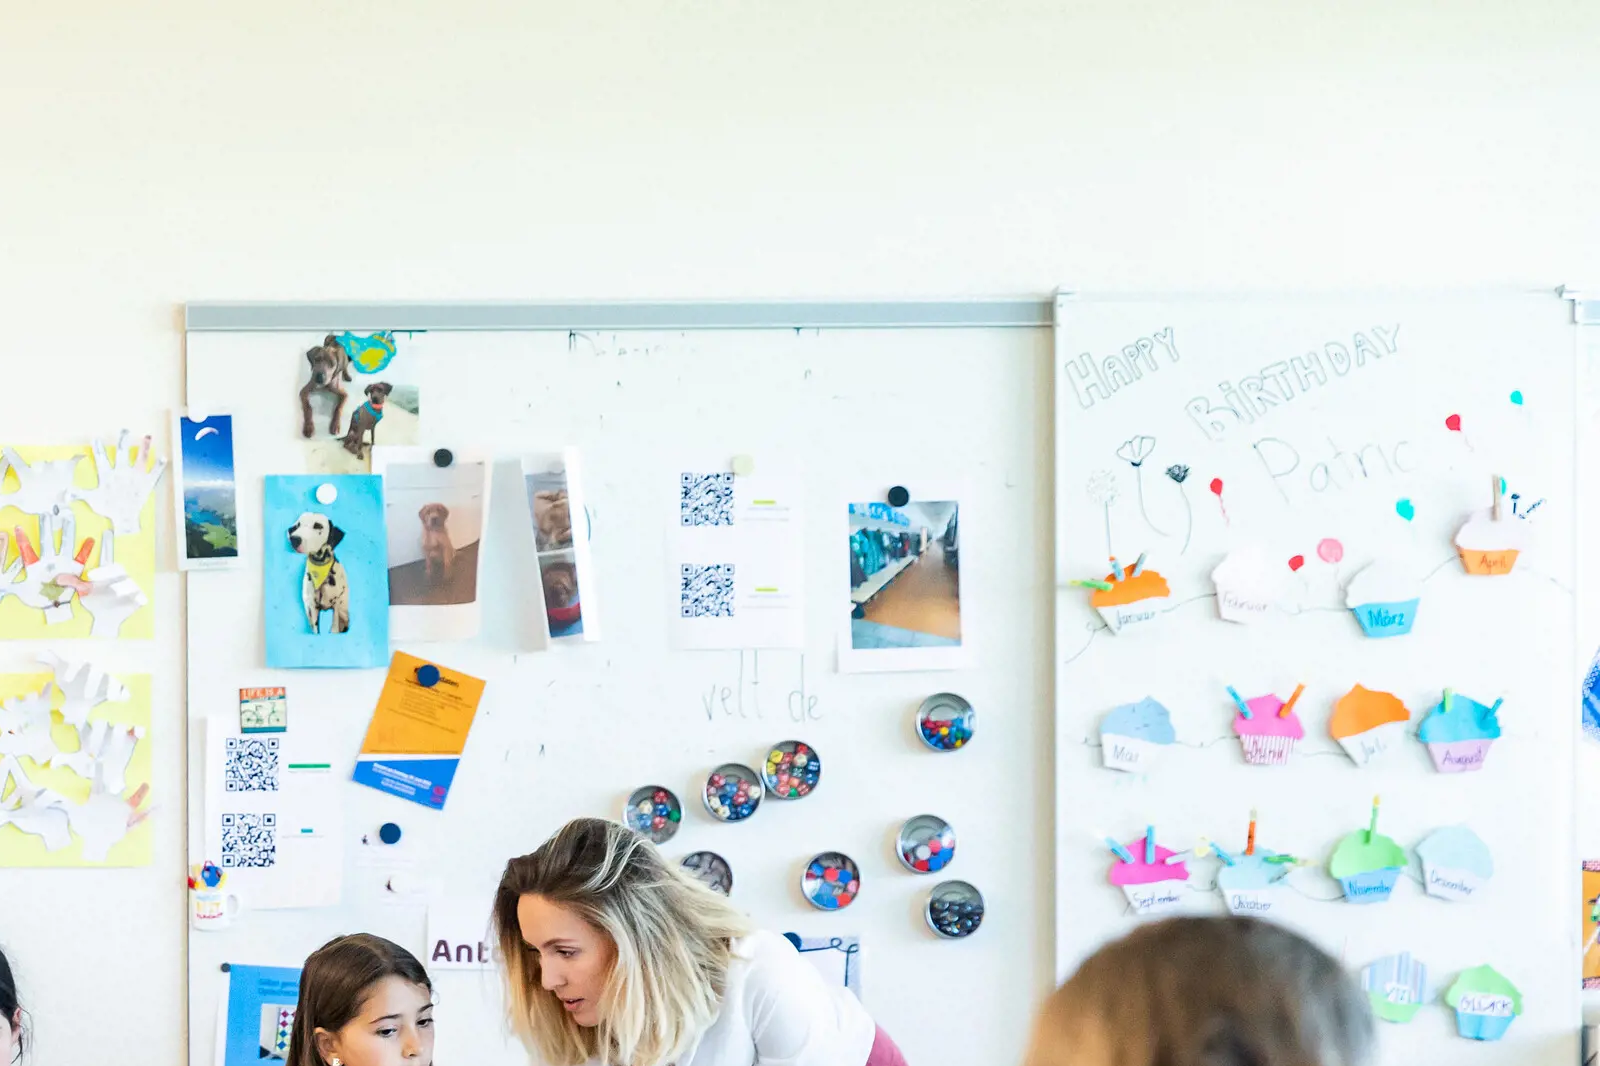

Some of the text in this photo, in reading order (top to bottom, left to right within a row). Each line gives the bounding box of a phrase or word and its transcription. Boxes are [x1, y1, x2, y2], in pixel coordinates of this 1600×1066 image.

[1064, 326, 1180, 409] HAPPY
[1253, 436, 1416, 505] Patric
[1368, 608, 1405, 628] März
[431, 938, 489, 963] Ant
